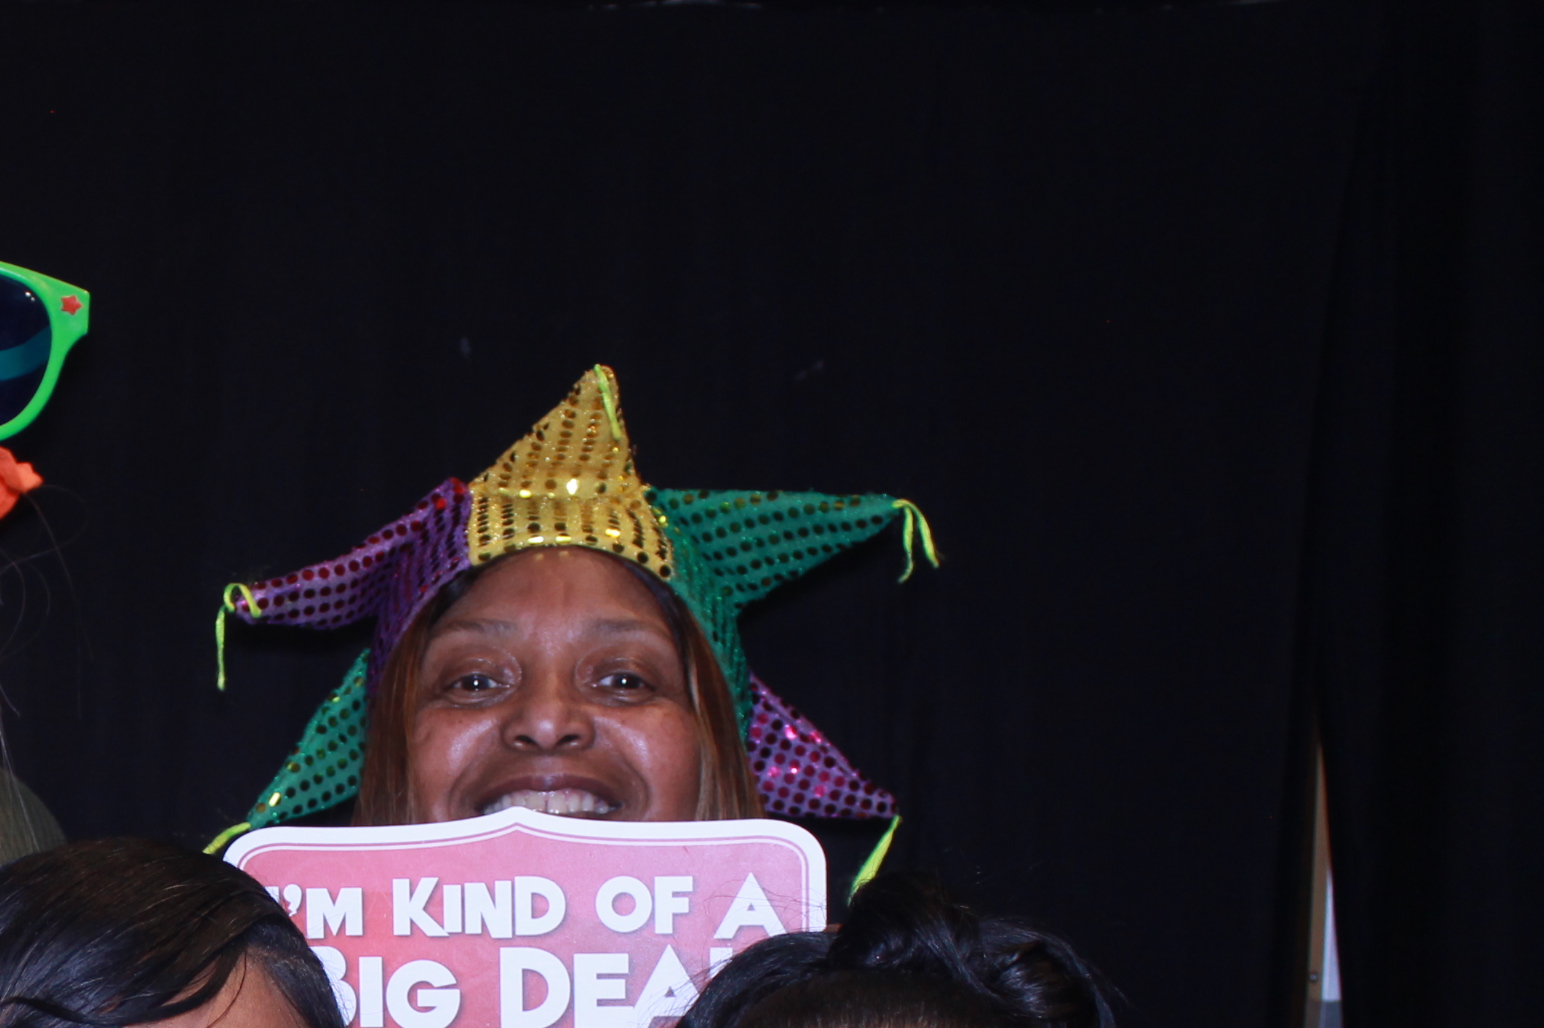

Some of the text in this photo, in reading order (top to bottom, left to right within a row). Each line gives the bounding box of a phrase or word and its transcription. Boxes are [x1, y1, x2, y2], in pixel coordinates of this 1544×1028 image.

[264, 872, 788, 940] 'M KIND OF A
